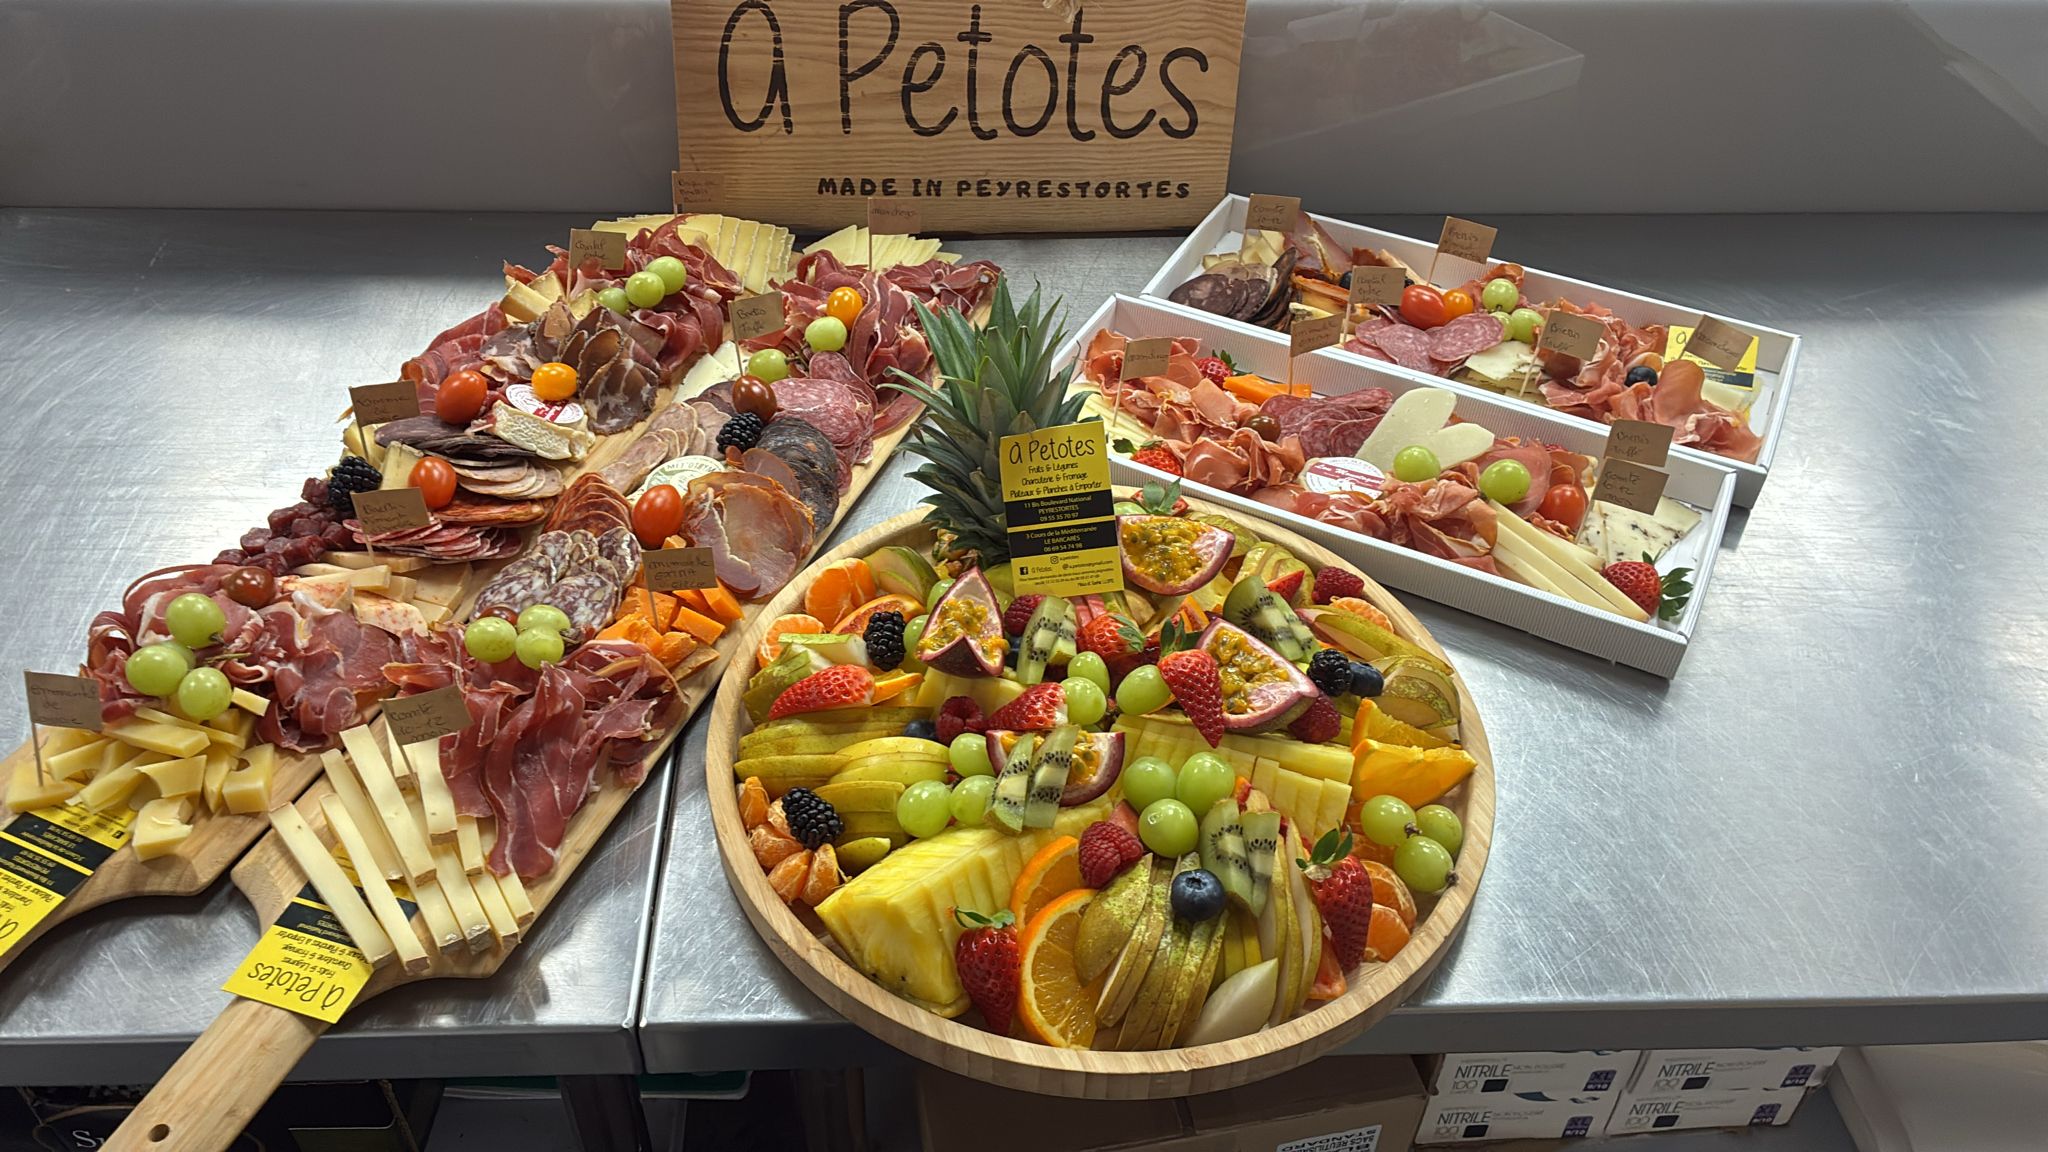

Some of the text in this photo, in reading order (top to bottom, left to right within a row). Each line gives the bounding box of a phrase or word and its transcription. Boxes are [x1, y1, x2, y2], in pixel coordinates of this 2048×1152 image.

[839, 0, 1209, 141] Petotes
[817, 177, 1190, 199] MADE IN PEYRESTORTES
[1029, 436, 1095, 462] Petotes
[1028, 466, 1044, 474] Fruits
[1063, 472, 1088, 481] Fromage
[247, 962, 325, 1002] Petotes
[1454, 1064, 1513, 1079] NITRILE
[1657, 1062, 1715, 1078] NITRILE
[1452, 1080, 1478, 1090] 100
[1628, 1101, 1685, 1115] NITRILE
[1437, 1111, 1493, 1125] NITRILE
[1282, 1130, 1377, 1152] STANDARD
